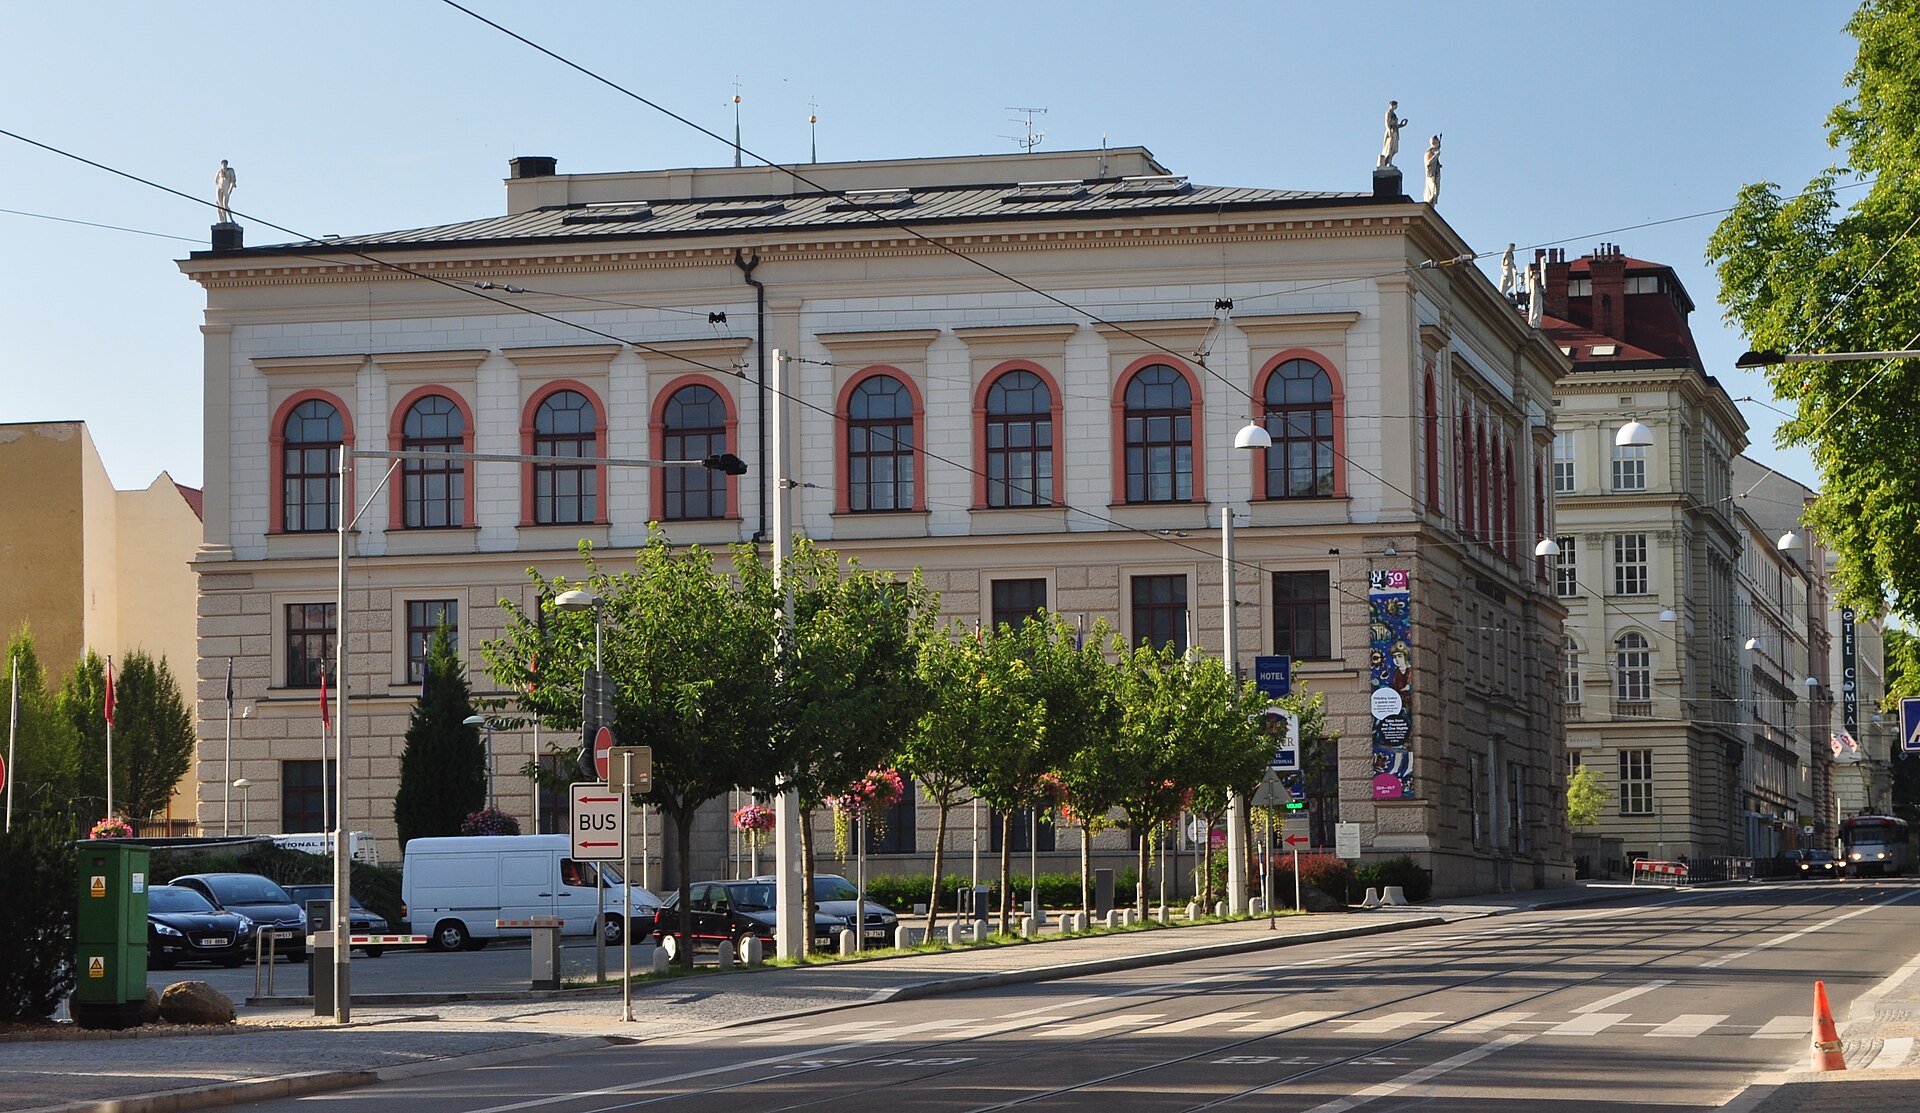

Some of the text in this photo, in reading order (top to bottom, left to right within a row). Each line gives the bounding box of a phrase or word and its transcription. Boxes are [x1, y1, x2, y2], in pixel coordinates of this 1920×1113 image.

[1388, 572, 1403, 586] 50
[1260, 672, 1285, 681] HOTEL
[579, 813, 617, 831] BUS
